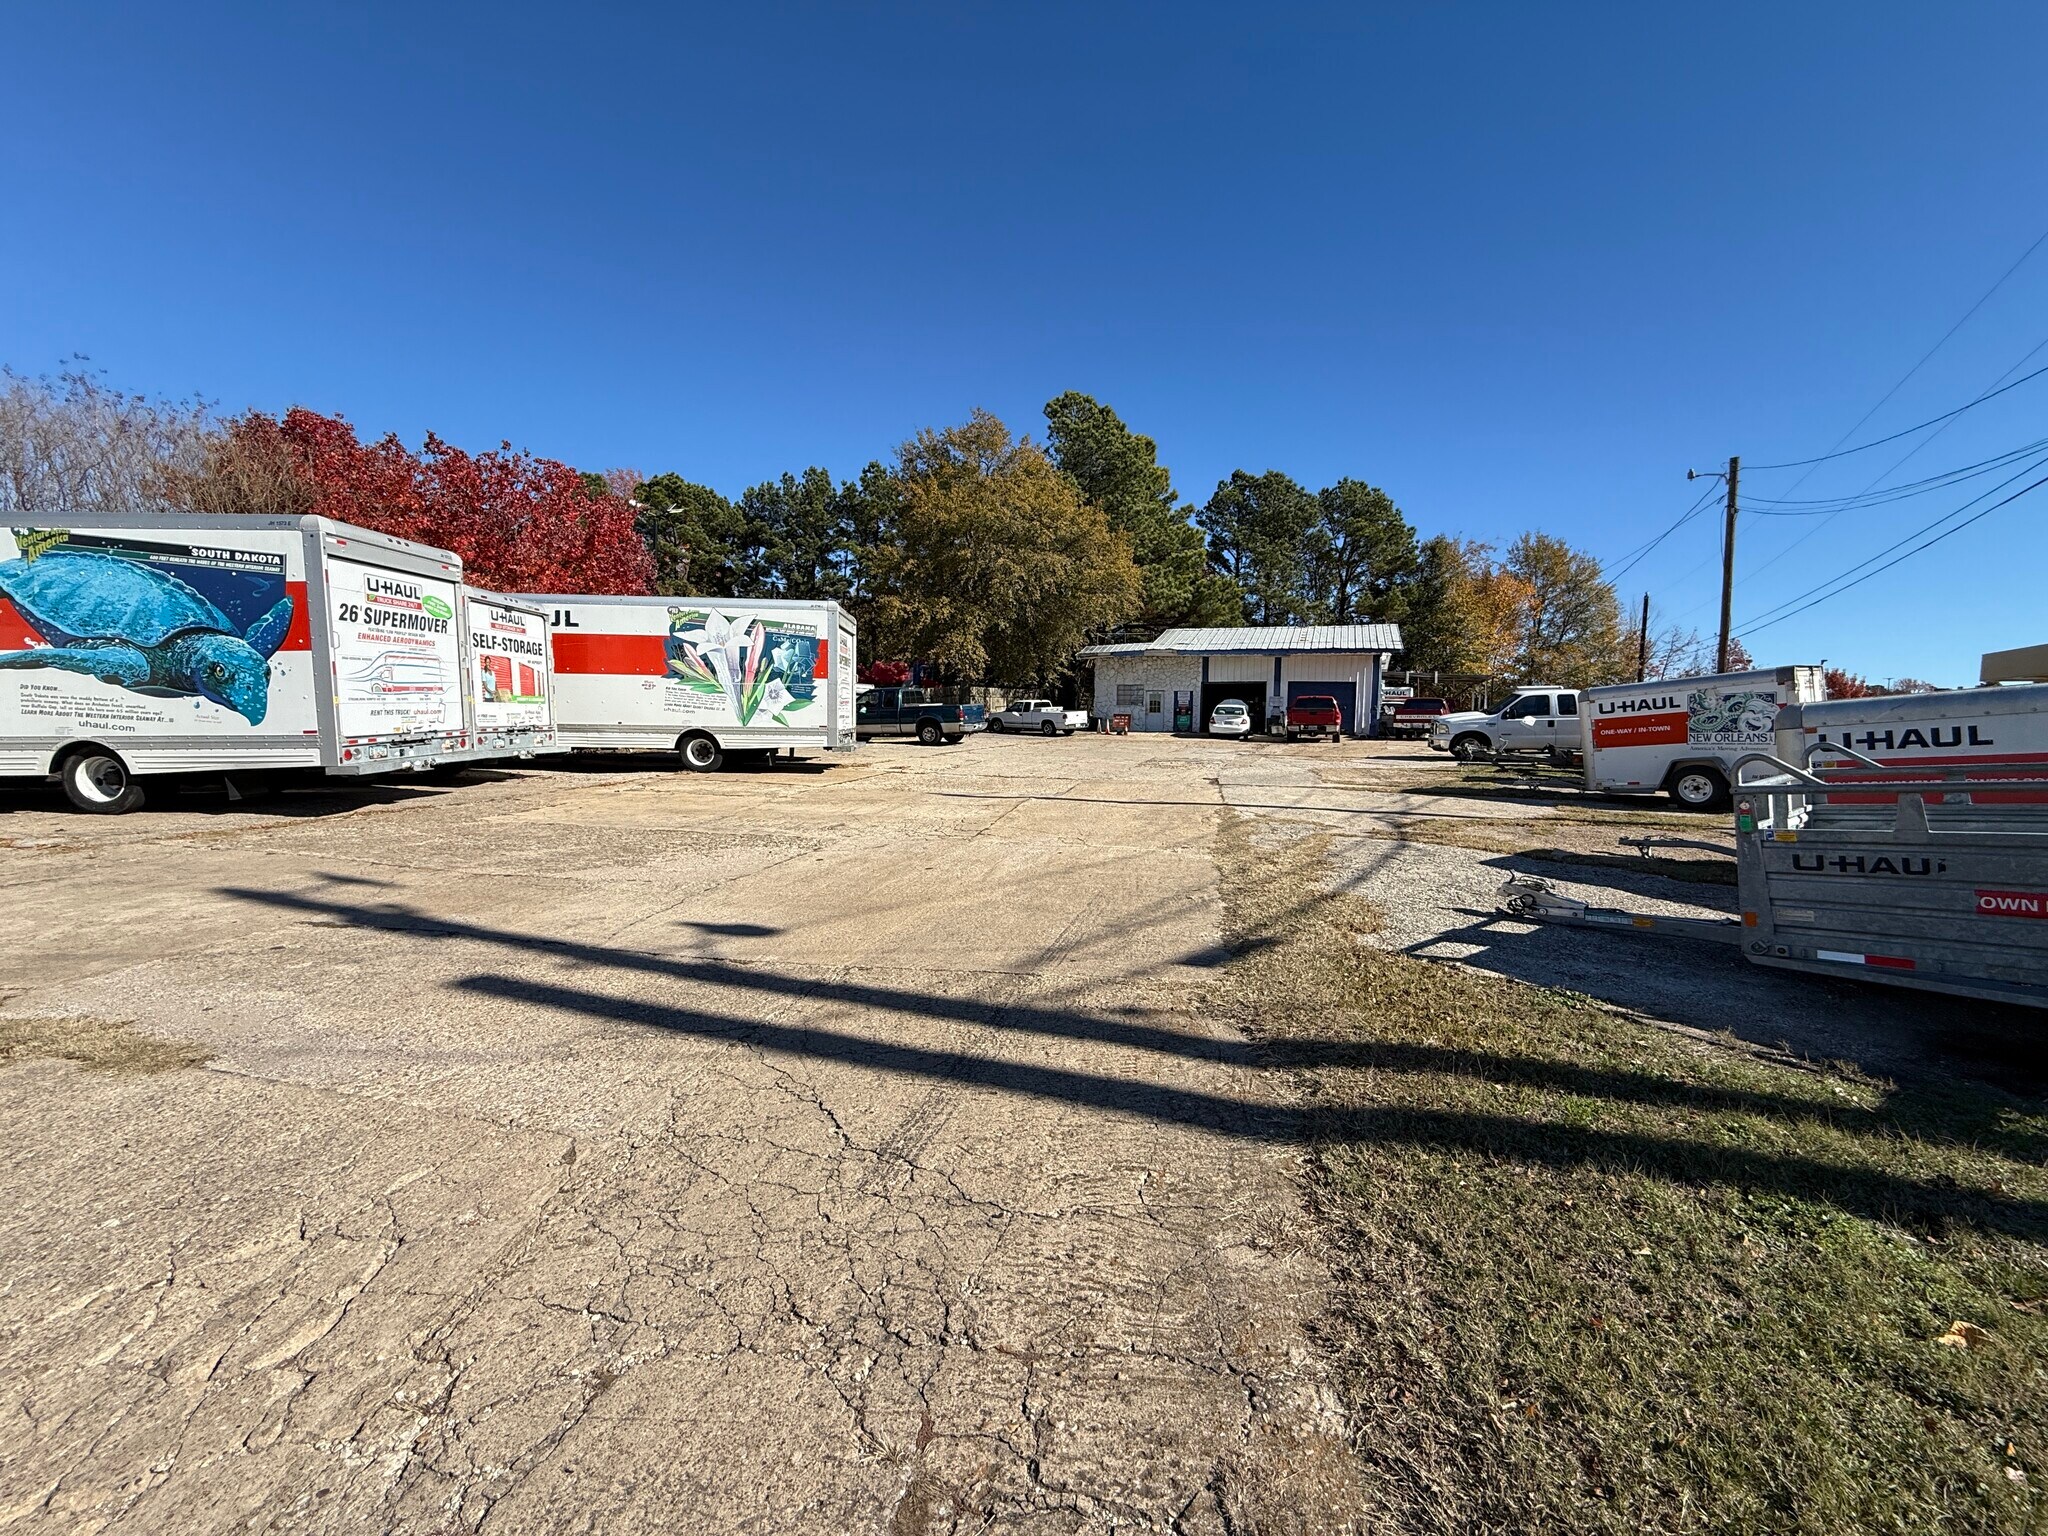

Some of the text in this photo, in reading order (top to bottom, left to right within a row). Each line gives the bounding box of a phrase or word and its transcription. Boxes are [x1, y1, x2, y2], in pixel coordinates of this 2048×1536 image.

[28, 534, 68, 564] America
[191, 548, 280, 564] SOUTH DAKOTA
[367, 578, 420, 600] U-HAUL
[364, 606, 448, 634] SUPERMOVER
[491, 610, 525, 626] U-HAUL
[783, 623, 815, 631] ALABAMA
[358, 632, 435, 646] ENHANCED AERODYNAMICS
[472, 632, 543, 656] SELF-STORAGE
[1598, 696, 1681, 714] U-HAUL
[78, 720, 135, 732] uhaul.com
[1600, 728, 1633, 736] ONE-WAY
[1689, 733, 1712, 742] NEW
[1714, 733, 1768, 742] ORLEANS
[1980, 896, 2038, 912] OWN
